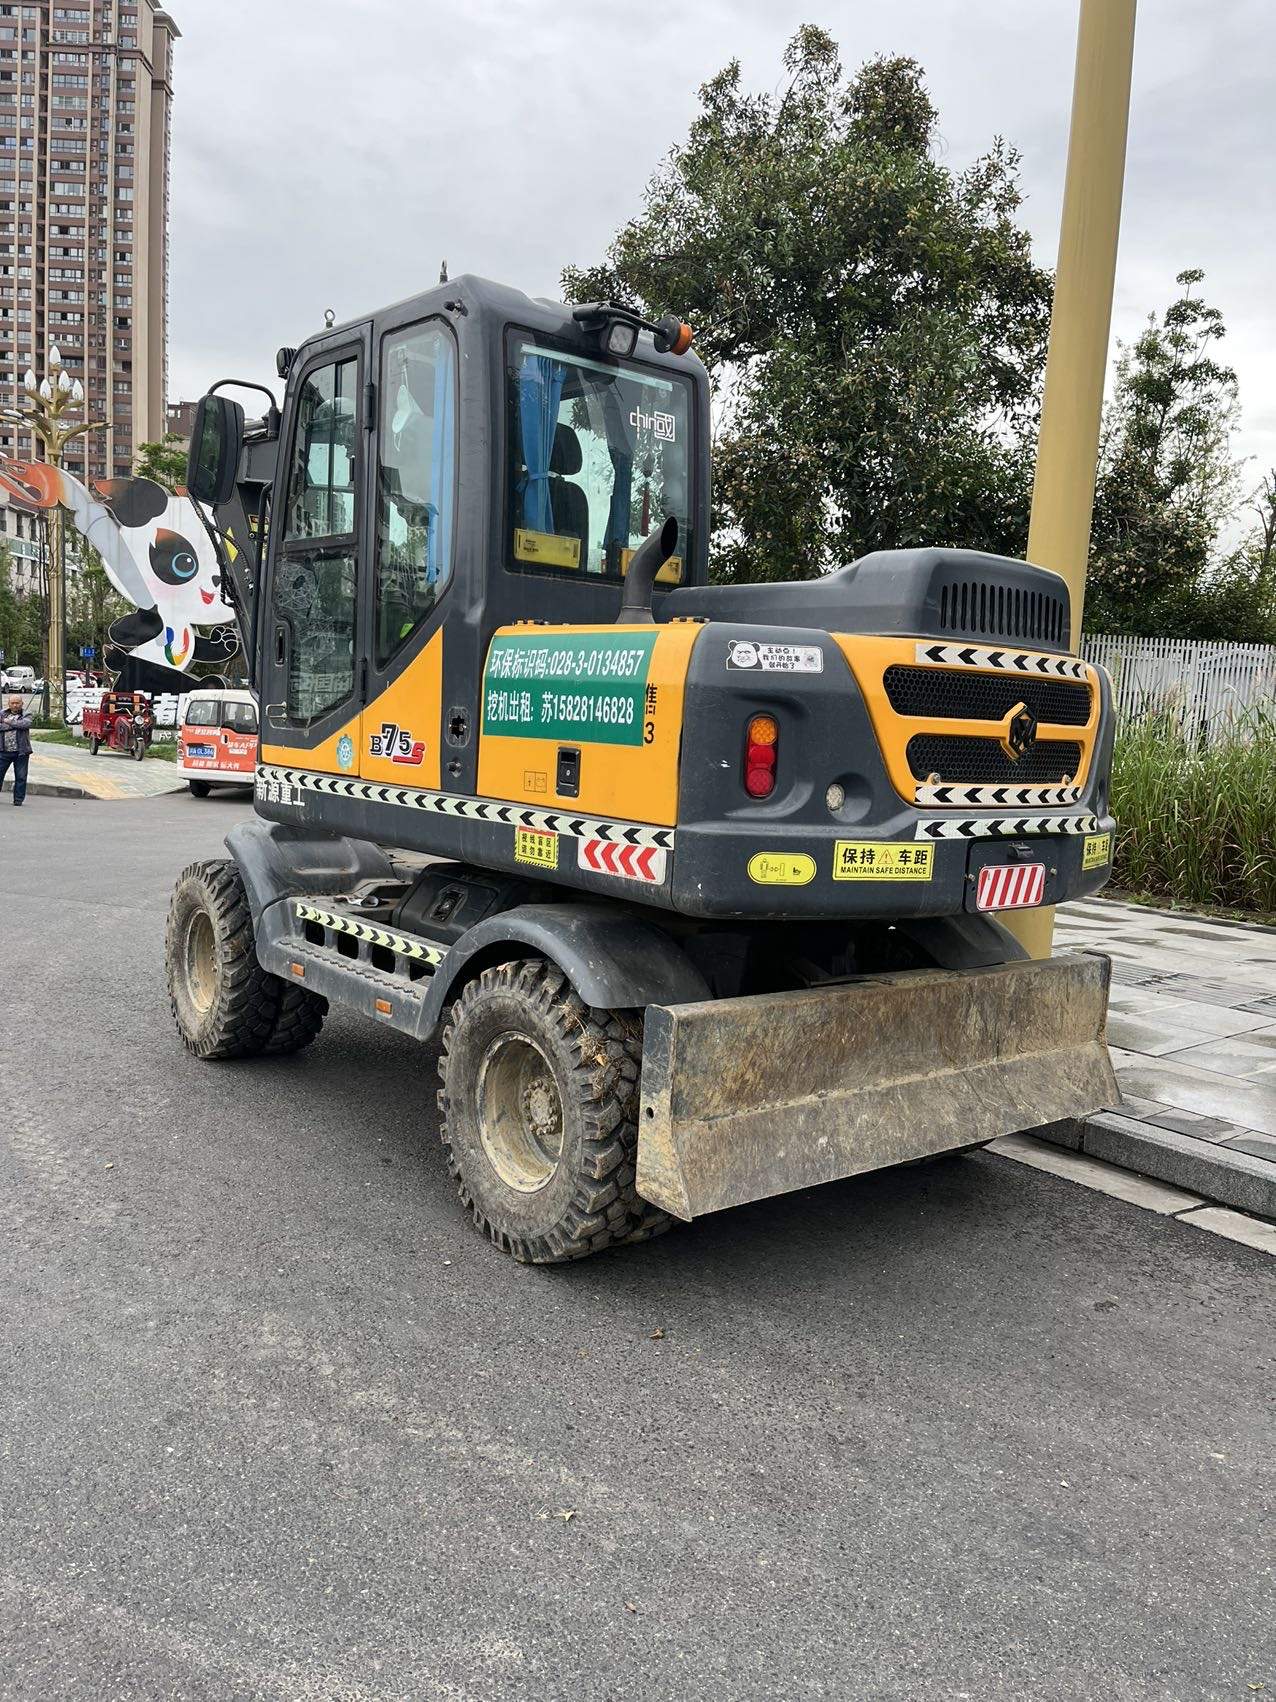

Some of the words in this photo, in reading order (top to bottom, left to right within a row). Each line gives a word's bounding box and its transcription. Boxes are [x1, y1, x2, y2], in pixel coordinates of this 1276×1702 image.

[489, 648, 645, 678] 环保标识码:028-3-0134857
[541, 691, 634, 725] 苏15828146828
[256, 778, 305, 806] 新源重工
[842, 847, 875, 865] 保持
[898, 848, 928, 865] 车距
[895, 867, 927, 875] DISTANCE
